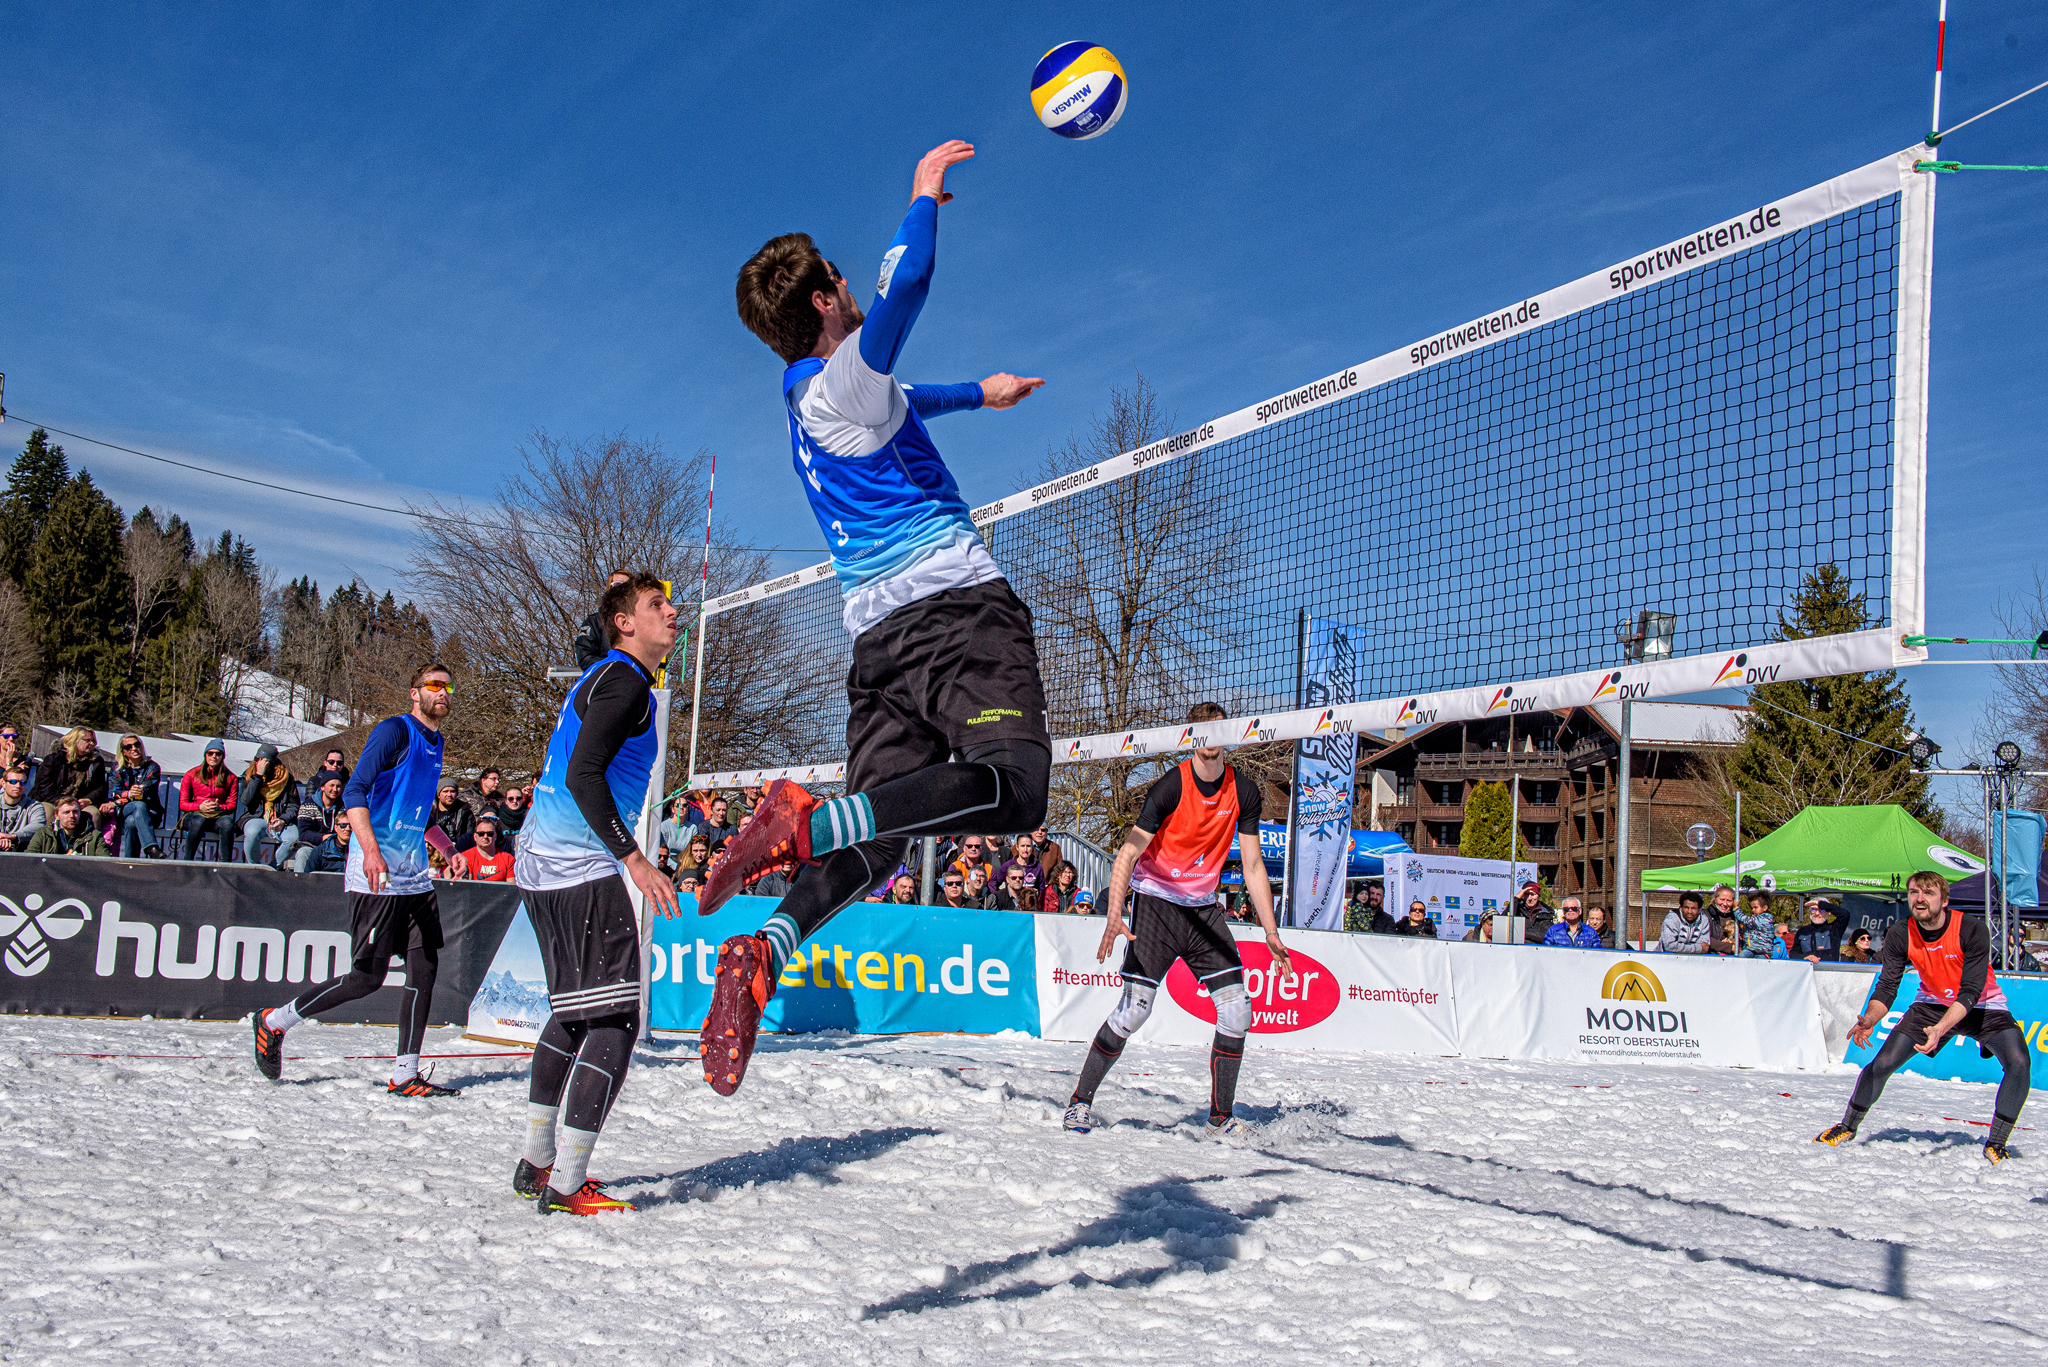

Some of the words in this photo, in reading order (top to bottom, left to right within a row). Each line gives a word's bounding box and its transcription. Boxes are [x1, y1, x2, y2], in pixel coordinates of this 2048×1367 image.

[1051, 84, 1092, 116] MIKASA
[1610, 207, 1781, 297] sportwetten.de
[1410, 300, 1541, 367] sportwetten.de
[1256, 369, 1358, 424] sportwetten.de
[1132, 423, 1214, 468] sportwetten.de
[1031, 466, 1099, 503] sportwetten.de
[831, 520, 849, 547] 3
[1746, 664, 1781, 685] DVV
[1619, 681, 1650, 700] DVV
[1511, 696, 1537, 713] DVV
[1415, 709, 1438, 725] DVV
[1259, 728, 1277, 742] DVV
[1333, 719, 1352, 734] DVV
[1133, 742, 1147, 755] DVV
[1192, 735, 1208, 749] DVV
[1079, 748, 1093, 761] DVV
[544, 755, 553, 776] 4
[415, 806, 422, 820] 1
[1296, 807, 1346, 827] Volleyball
[1298, 802, 1326, 815] Snow
[480, 864, 497, 874] NIKE
[1194, 853, 1205, 868] 4
[1480, 871, 1512, 879] MEISTERSCHAFTE
[1786, 878, 1799, 887] WIR
[1799, 877, 1815, 886] SIND
[1816, 877, 1827, 886] DIE
[1828, 877, 1883, 887] LAUFEXPERTEN
[1304, 907, 1323, 928] beach,
[1860, 914, 1883, 930] Der
[95, 900, 407, 987] humm
[1052, 967, 1123, 988] #teamtö
[1243, 959, 1319, 1006] pfer
[1348, 984, 1439, 1007] #teamtöpfer
[1944, 988, 1955, 999] 2
[497, 1017, 540, 1030] WINDOW2PRINT
[1251, 1009, 1299, 1027] ywelt
[1586, 1007, 1688, 1033] MONDI
[1579, 1034, 1621, 1045] RESORT
[1623, 1036, 1700, 1048] OBERSTAUFEN
[1581, 1048, 1702, 1059] www.mondihotels.com/oberstaufen
